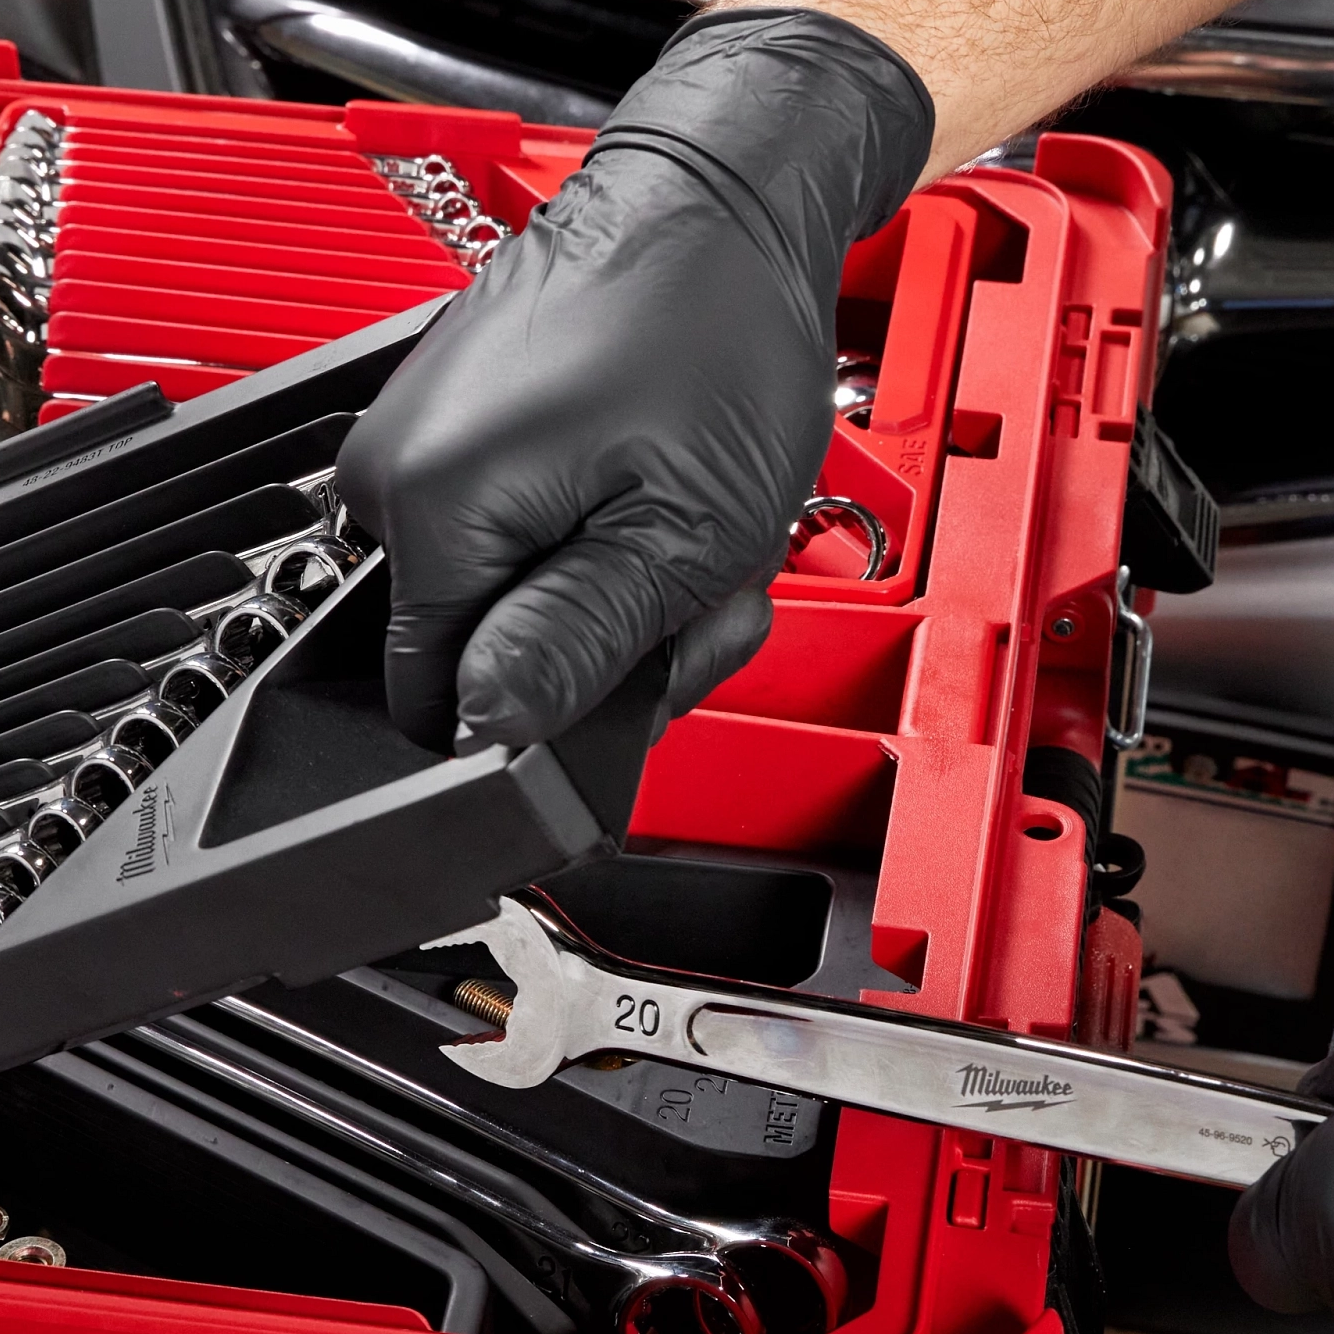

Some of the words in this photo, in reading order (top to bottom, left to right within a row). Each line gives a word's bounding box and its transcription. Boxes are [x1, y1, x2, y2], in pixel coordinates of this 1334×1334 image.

[108, 436, 133, 453] TOP
[898, 439, 927, 477] SAE
[116, 785, 158, 887] Milwaukee
[614, 994, 661, 1037] 20
[955, 1062, 1074, 1098] Milwaukee
[656, 1088, 695, 1123] 20
[763, 1090, 799, 1146] MET
[1198, 1127, 1253, 1146] 45-96-9520
